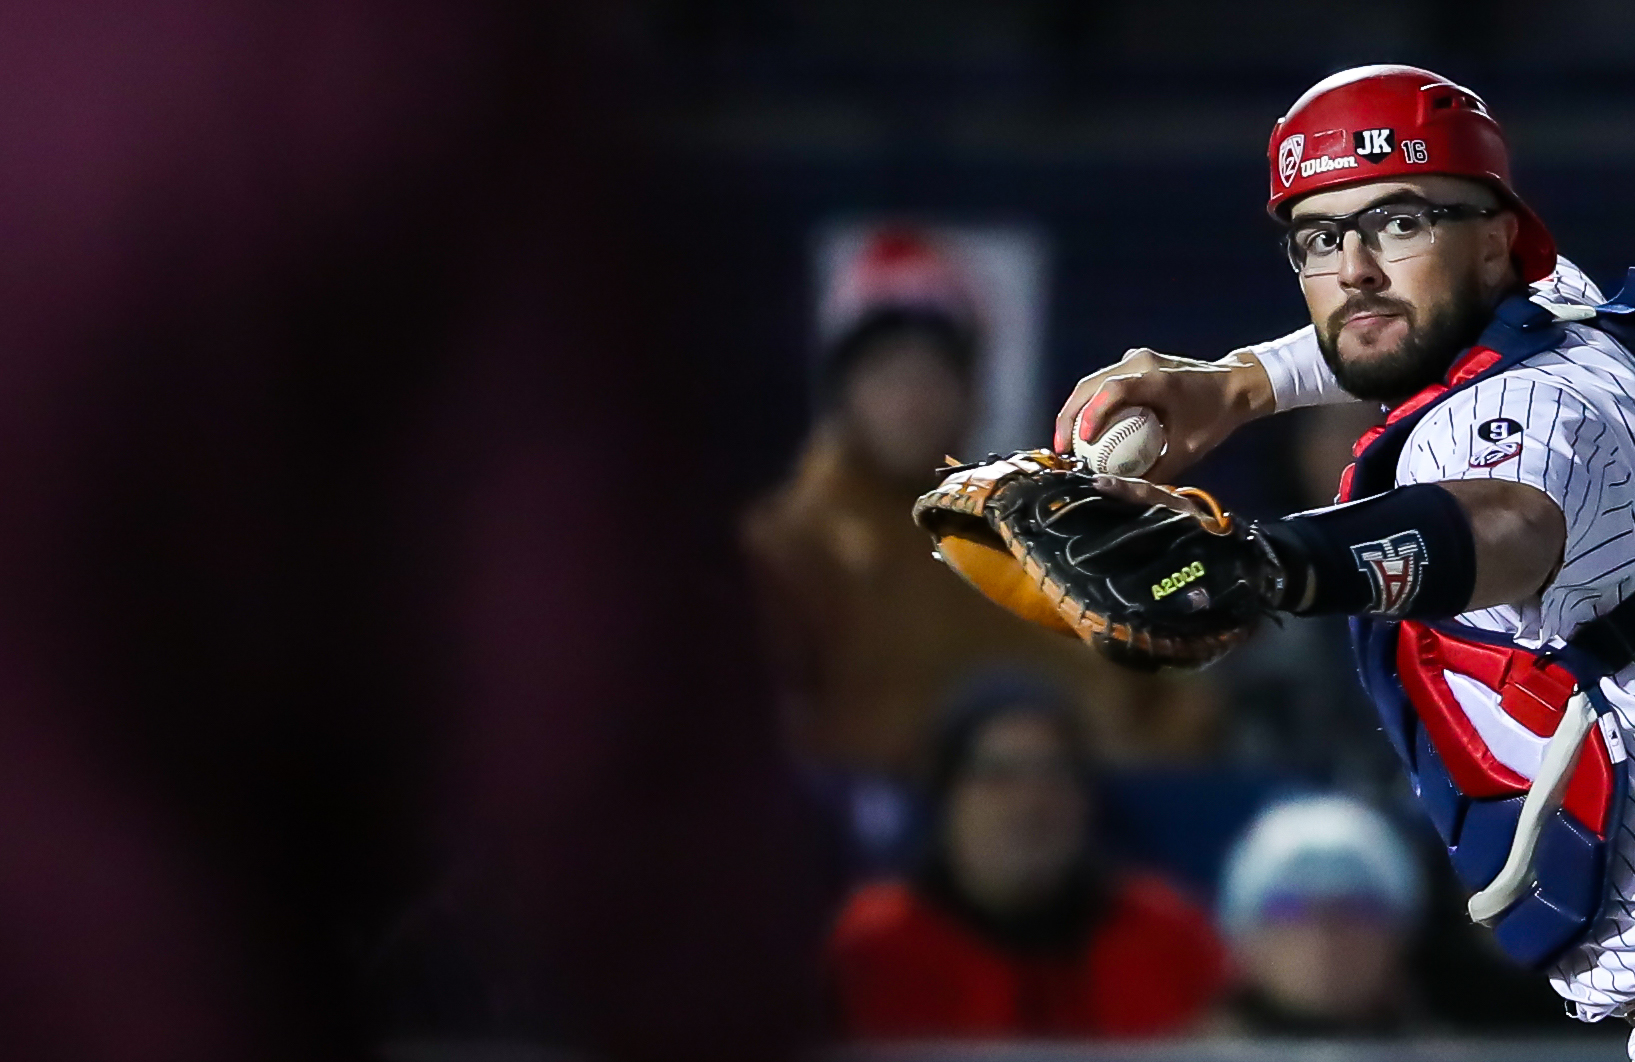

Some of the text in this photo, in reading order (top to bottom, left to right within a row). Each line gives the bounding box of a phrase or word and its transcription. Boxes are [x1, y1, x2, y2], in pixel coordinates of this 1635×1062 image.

[1357, 129, 1392, 155] JK
[1401, 139, 1428, 164] 16
[1300, 155, 1359, 178] Wilson
[1151, 561, 1205, 601] A2000
